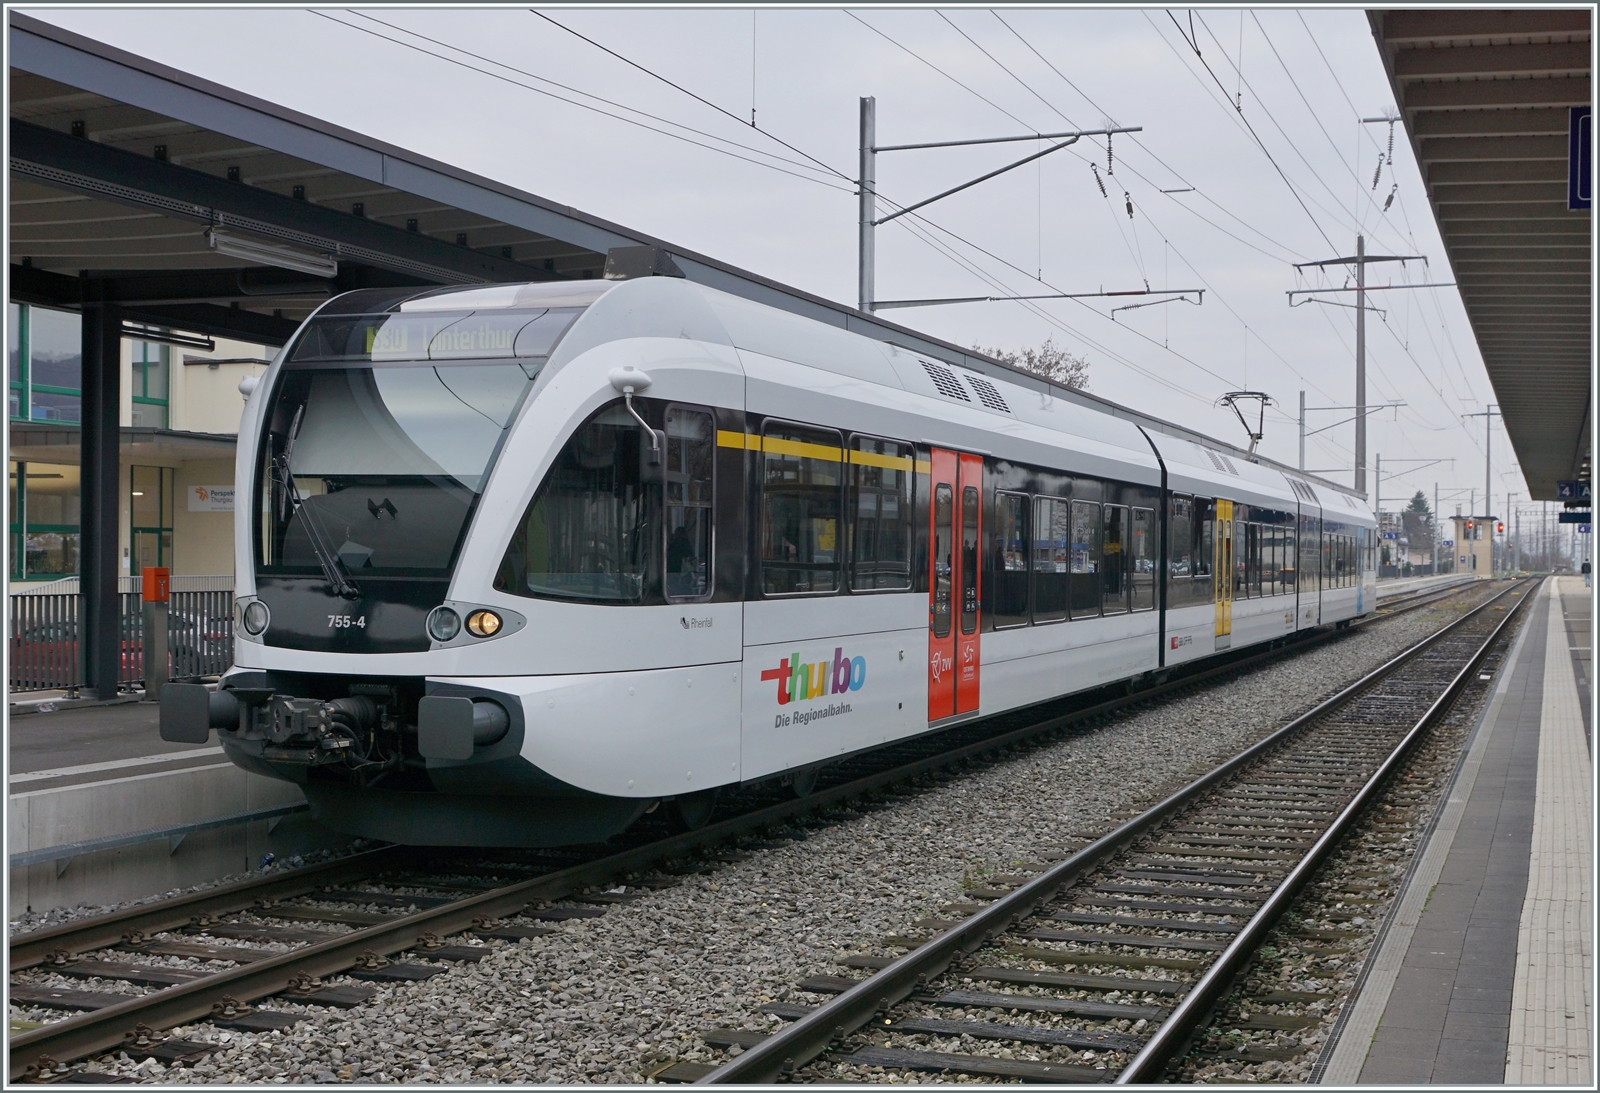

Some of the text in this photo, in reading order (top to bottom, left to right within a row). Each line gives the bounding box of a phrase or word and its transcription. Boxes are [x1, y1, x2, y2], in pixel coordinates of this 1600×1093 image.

[423, 323, 513, 351] Winterthur
[1562, 486, 1571, 496] 4
[327, 615, 366, 628] 755-4
[690, 617, 713, 629] Rheinfall
[942, 657, 952, 672] ZVV
[761, 647, 866, 705] thurbo
[775, 702, 853, 728] Die Regionalbahn.
